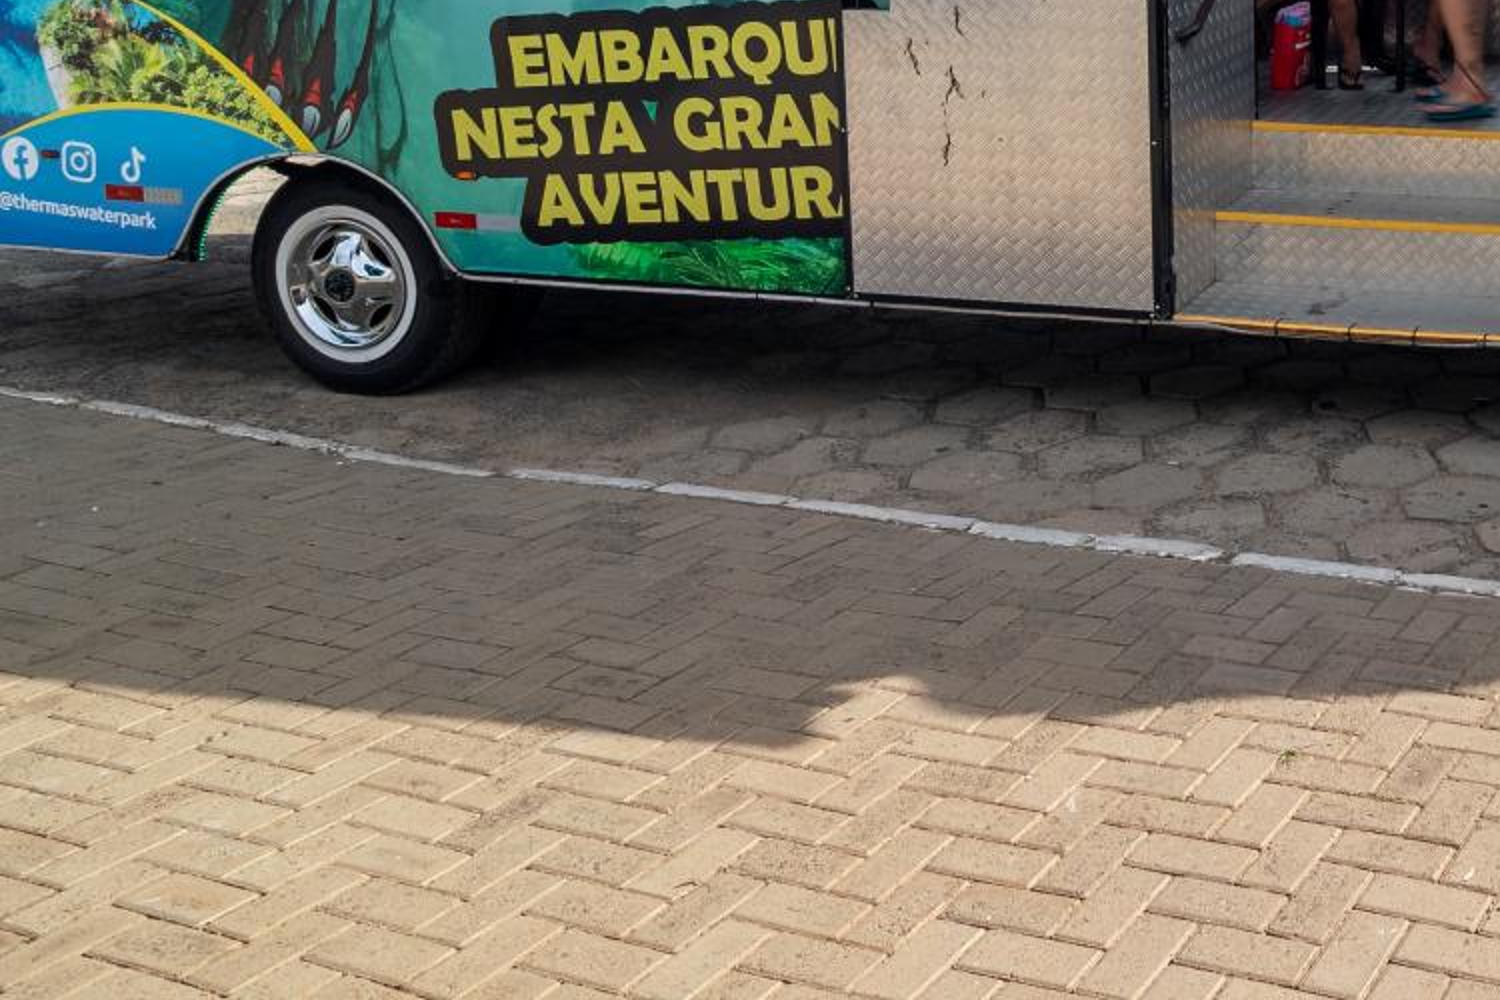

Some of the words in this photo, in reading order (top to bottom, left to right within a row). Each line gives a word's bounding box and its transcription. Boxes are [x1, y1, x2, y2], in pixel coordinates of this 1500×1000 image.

[507, 18, 837, 88] EMBARQU
[451, 100, 648, 163] NESTA
[0, 191, 157, 229] @thermaswaterpark
[537, 165, 844, 228] AVENTUR
